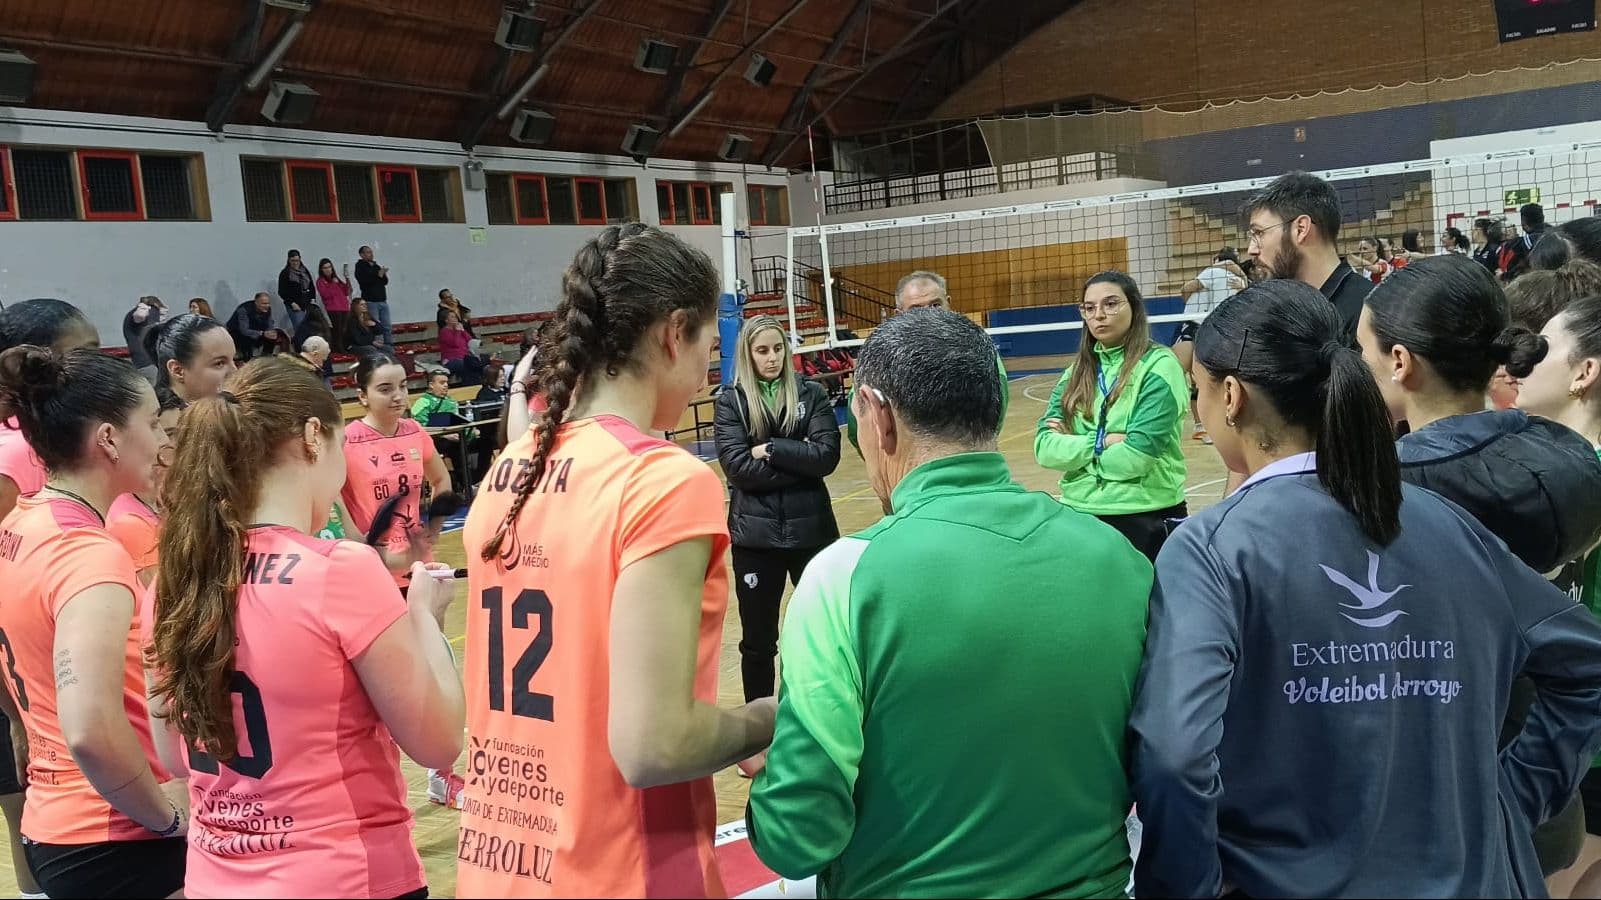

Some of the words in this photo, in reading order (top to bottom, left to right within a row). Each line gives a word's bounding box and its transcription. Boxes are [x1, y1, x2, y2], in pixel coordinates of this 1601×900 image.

[487, 457, 574, 494] LOZYA
[373, 484, 390, 501] GO
[242, 552, 302, 585] NEZ
[522, 556, 549, 569] MEDIO
[482, 586, 554, 723] 12
[1291, 634, 1454, 667] Extremadura
[1283, 673, 1389, 705] Voleibol
[1391, 671, 1463, 704] Arroyo
[492, 738, 544, 759] fundación
[486, 776, 564, 807] ydeporte
[482, 803, 494, 820] DE
